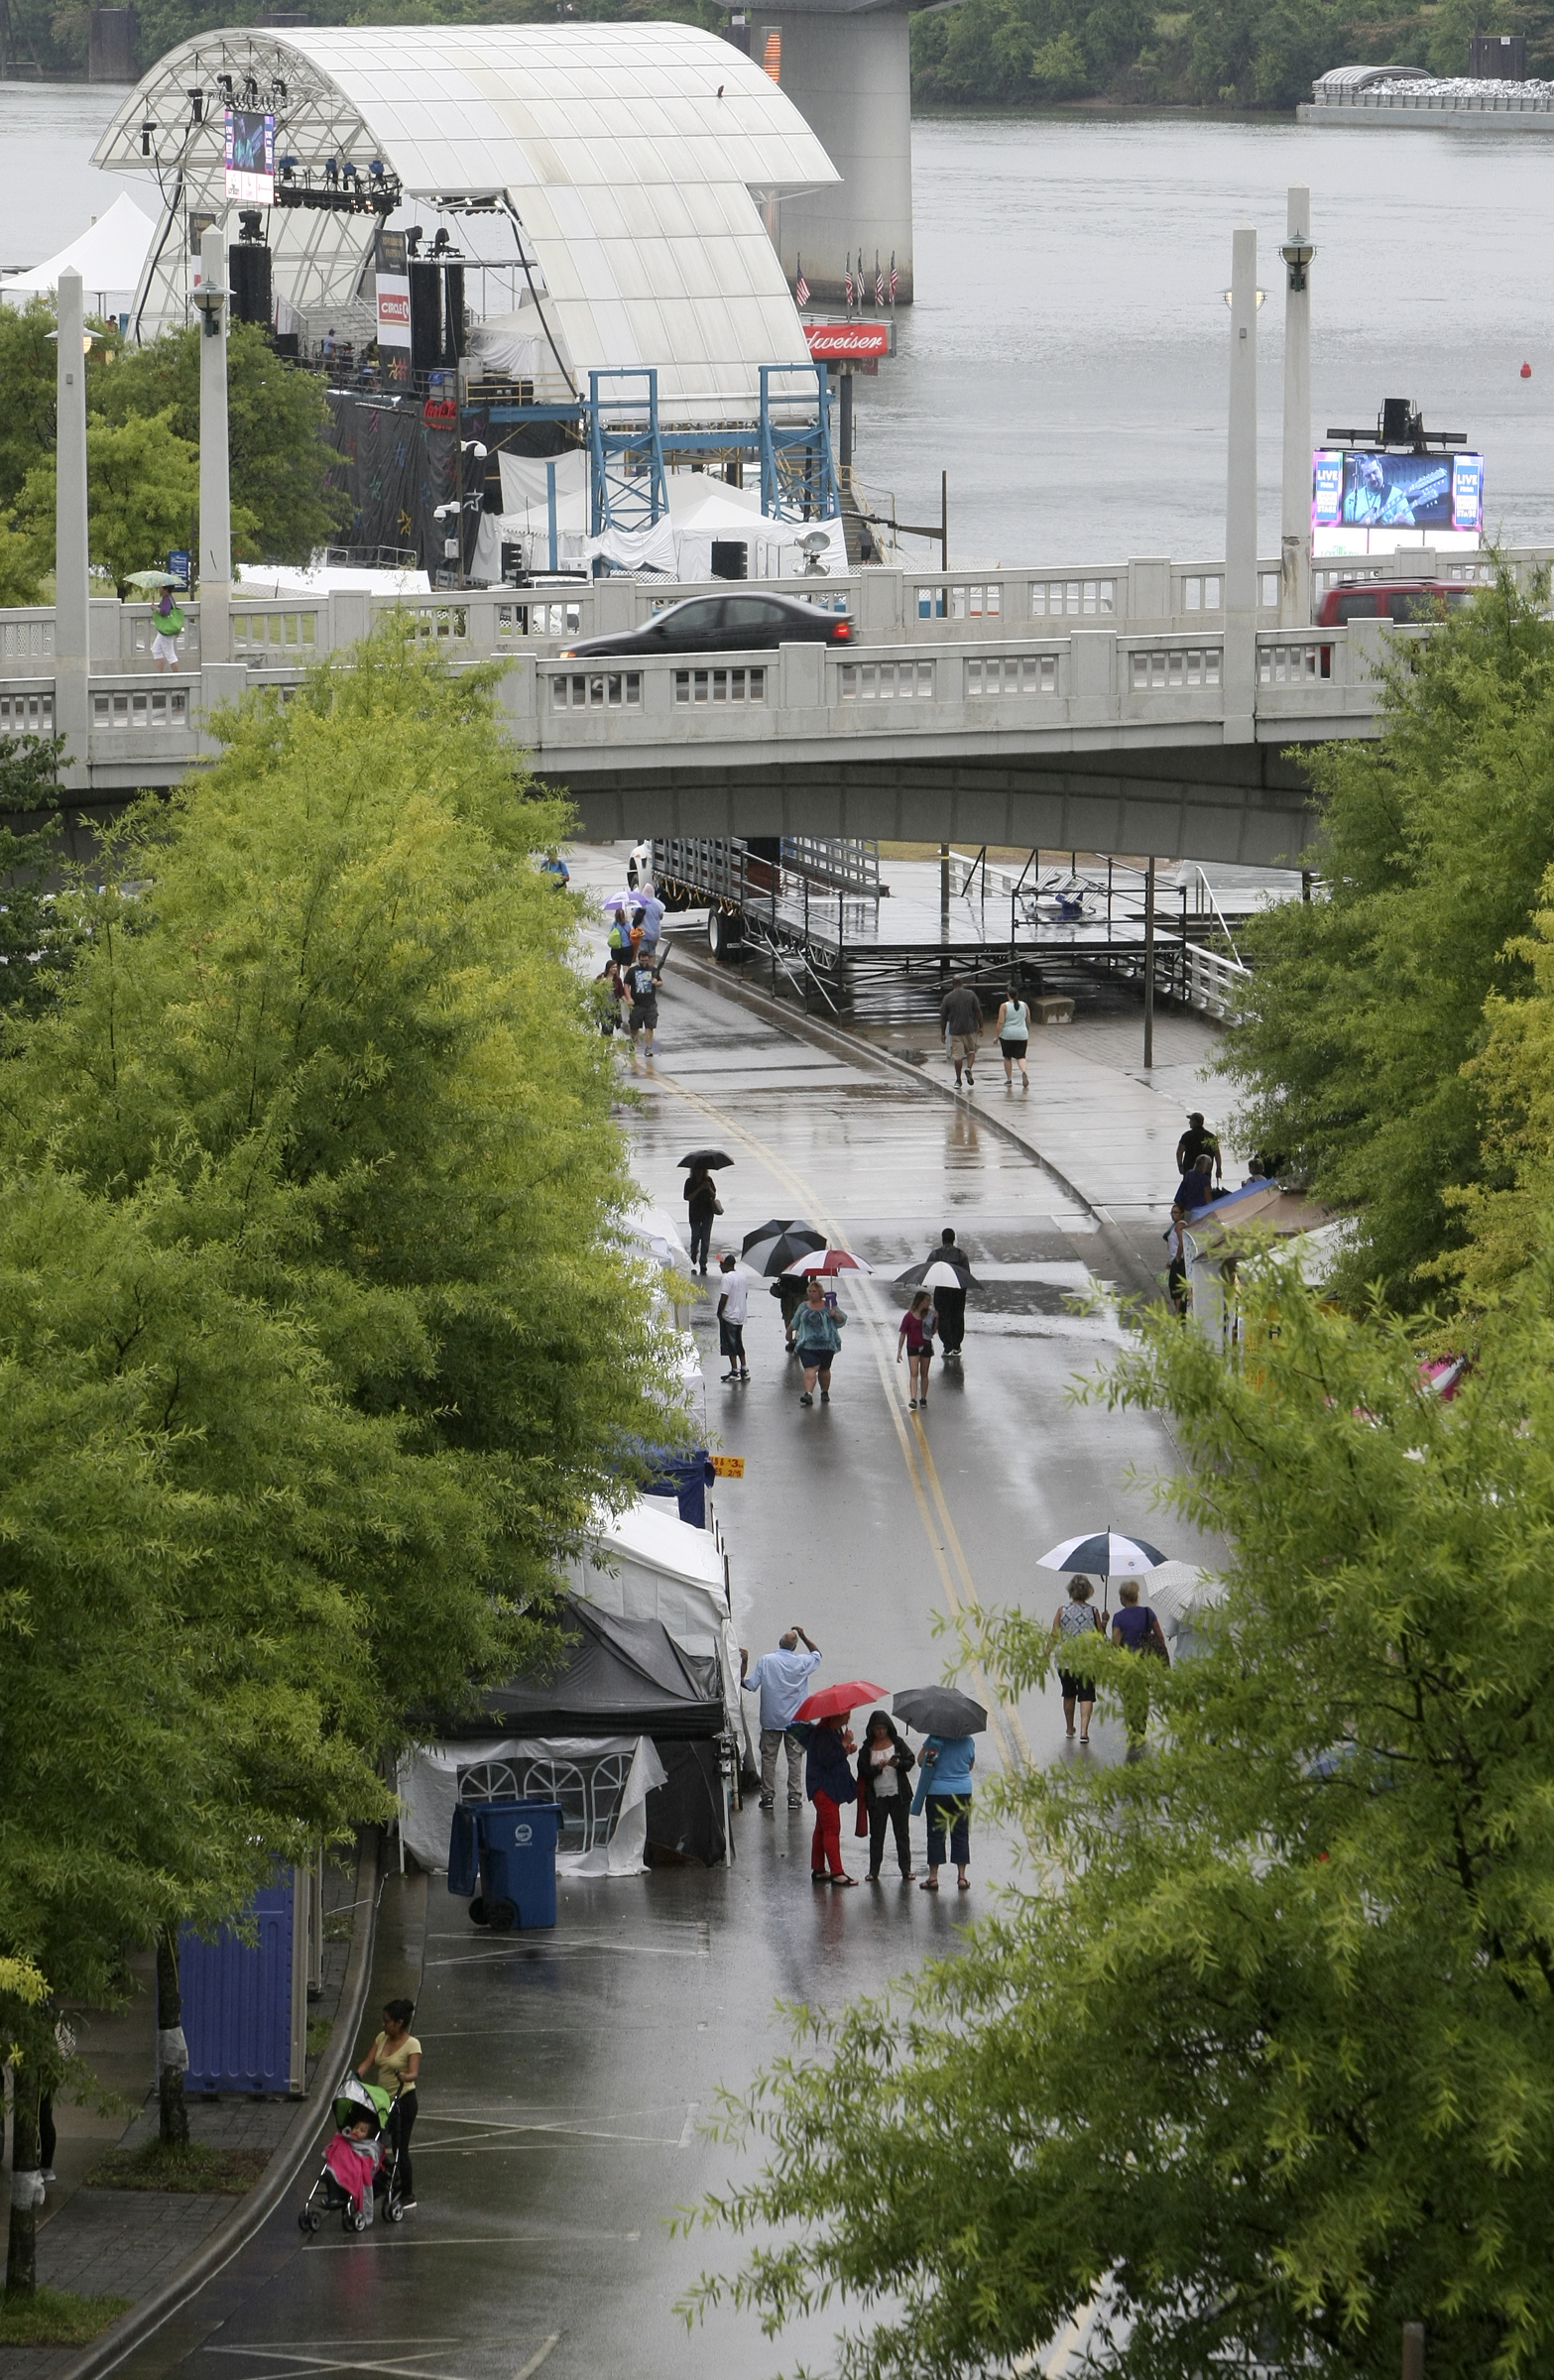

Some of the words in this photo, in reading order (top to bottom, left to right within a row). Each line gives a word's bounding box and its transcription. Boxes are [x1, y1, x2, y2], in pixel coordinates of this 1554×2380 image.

[381, 301, 403, 314] CIRCLE
[1317, 469, 1338, 481] LIVE
[1457, 474, 1478, 485] LIVE
